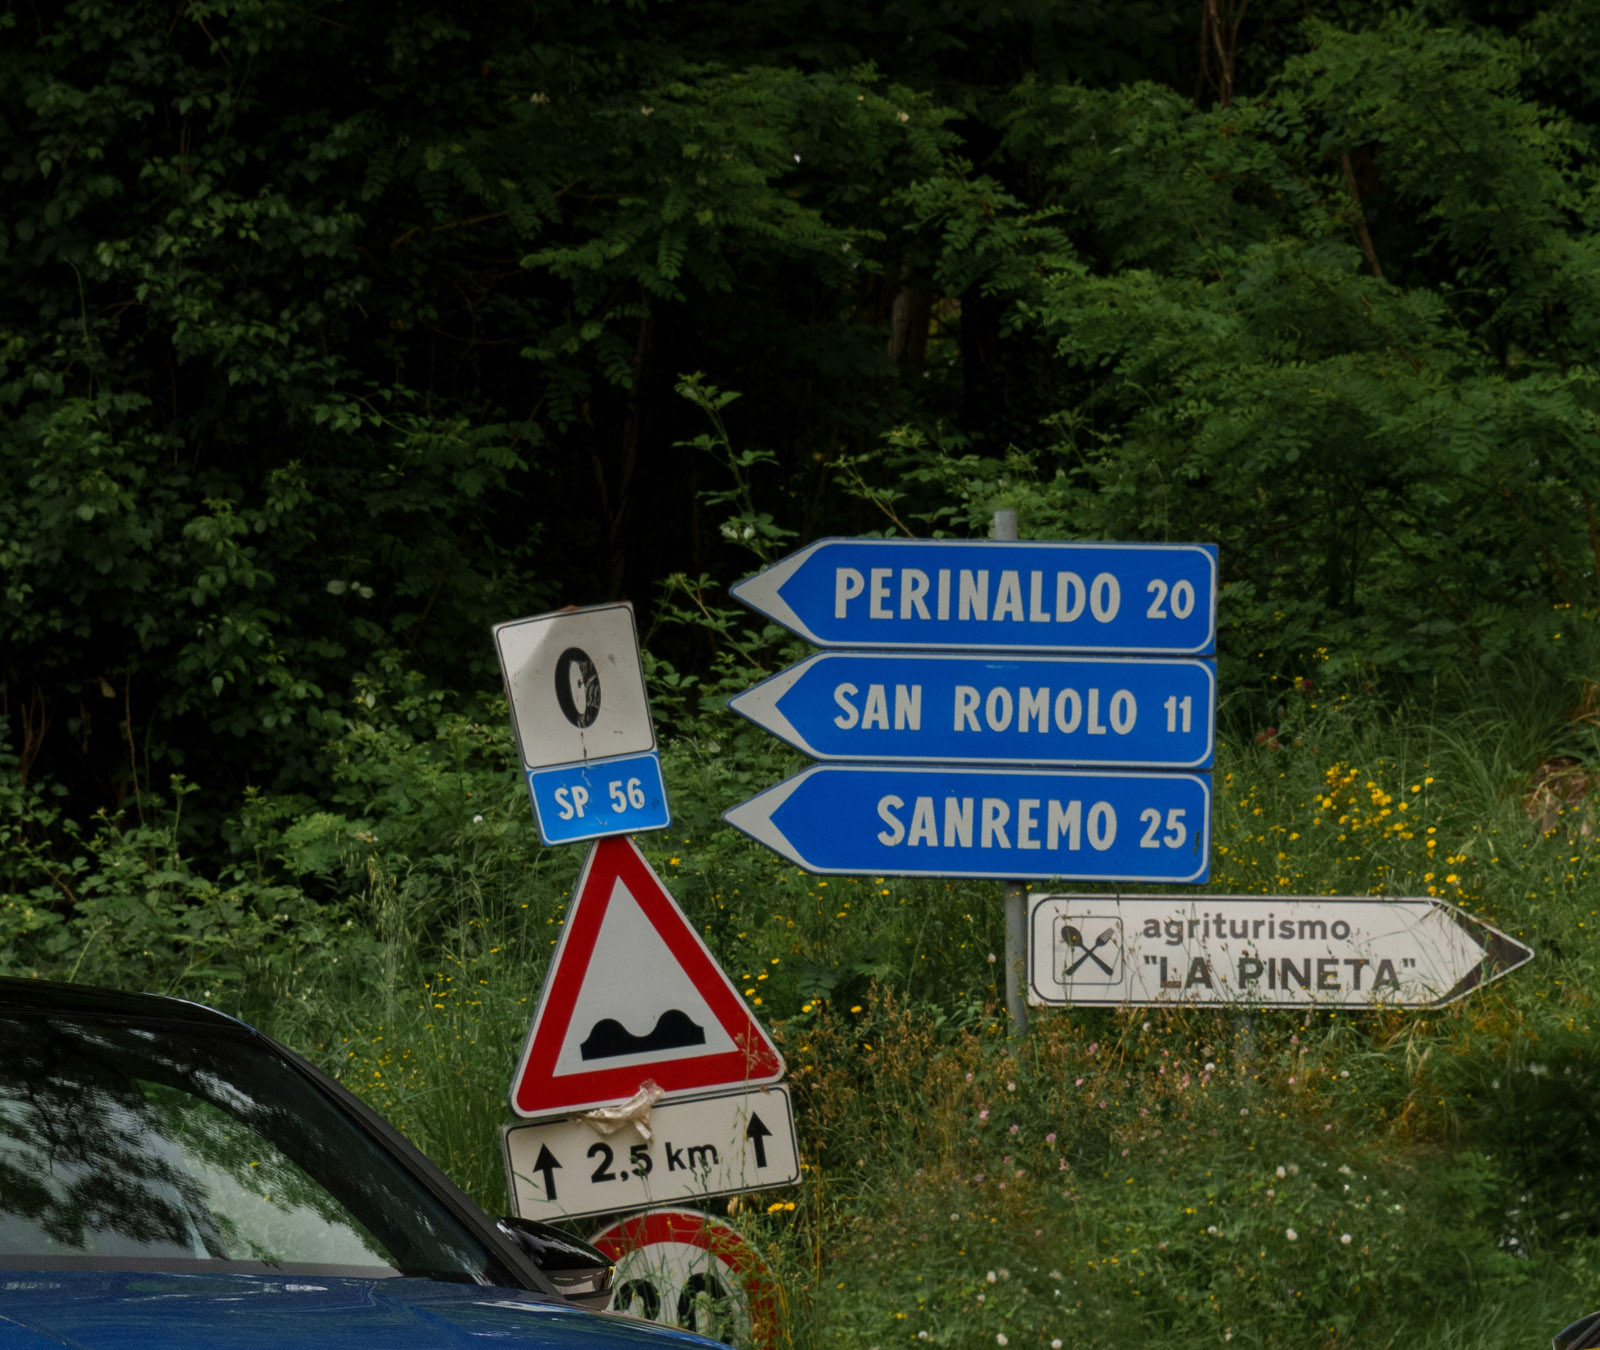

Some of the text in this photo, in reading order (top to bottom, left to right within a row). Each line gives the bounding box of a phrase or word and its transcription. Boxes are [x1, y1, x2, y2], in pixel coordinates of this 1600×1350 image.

[833, 567, 1196, 624] PERINALDO 20
[554, 646, 602, 730] 0
[832, 682, 1193, 735] SAN ROMOLO 11
[554, 777, 646, 820] SP 56
[876, 795, 1188, 851] SANREMO 25
[1142, 912, 1351, 947] agriturismo
[1142, 954, 1416, 991] "LA PINETA"
[586, 1141, 720, 1184] 2,5 km
